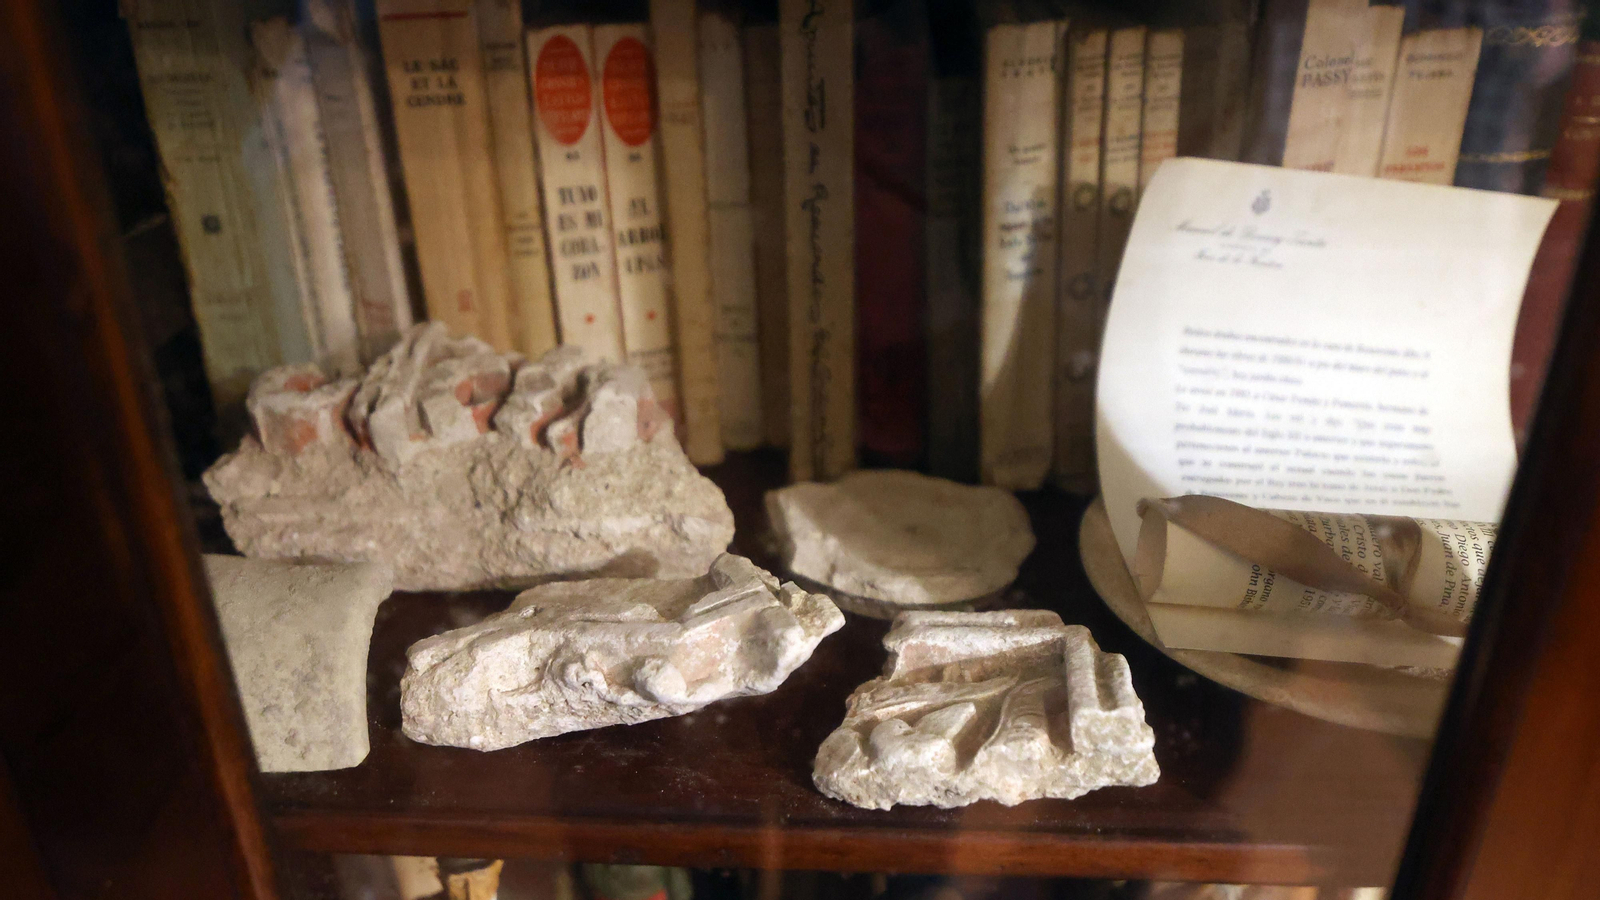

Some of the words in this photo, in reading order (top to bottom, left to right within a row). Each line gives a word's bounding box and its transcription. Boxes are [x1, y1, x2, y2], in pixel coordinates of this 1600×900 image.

[1301, 68, 1353, 90] PASSY
[1353, 524, 1368, 560] Cristo
[1437, 531, 1455, 559] Juan
[1454, 533, 1471, 567] Diego
[1259, 568, 1277, 602] rgano
[1445, 561, 1458, 577] de
[1452, 572, 1472, 617] Antonio
